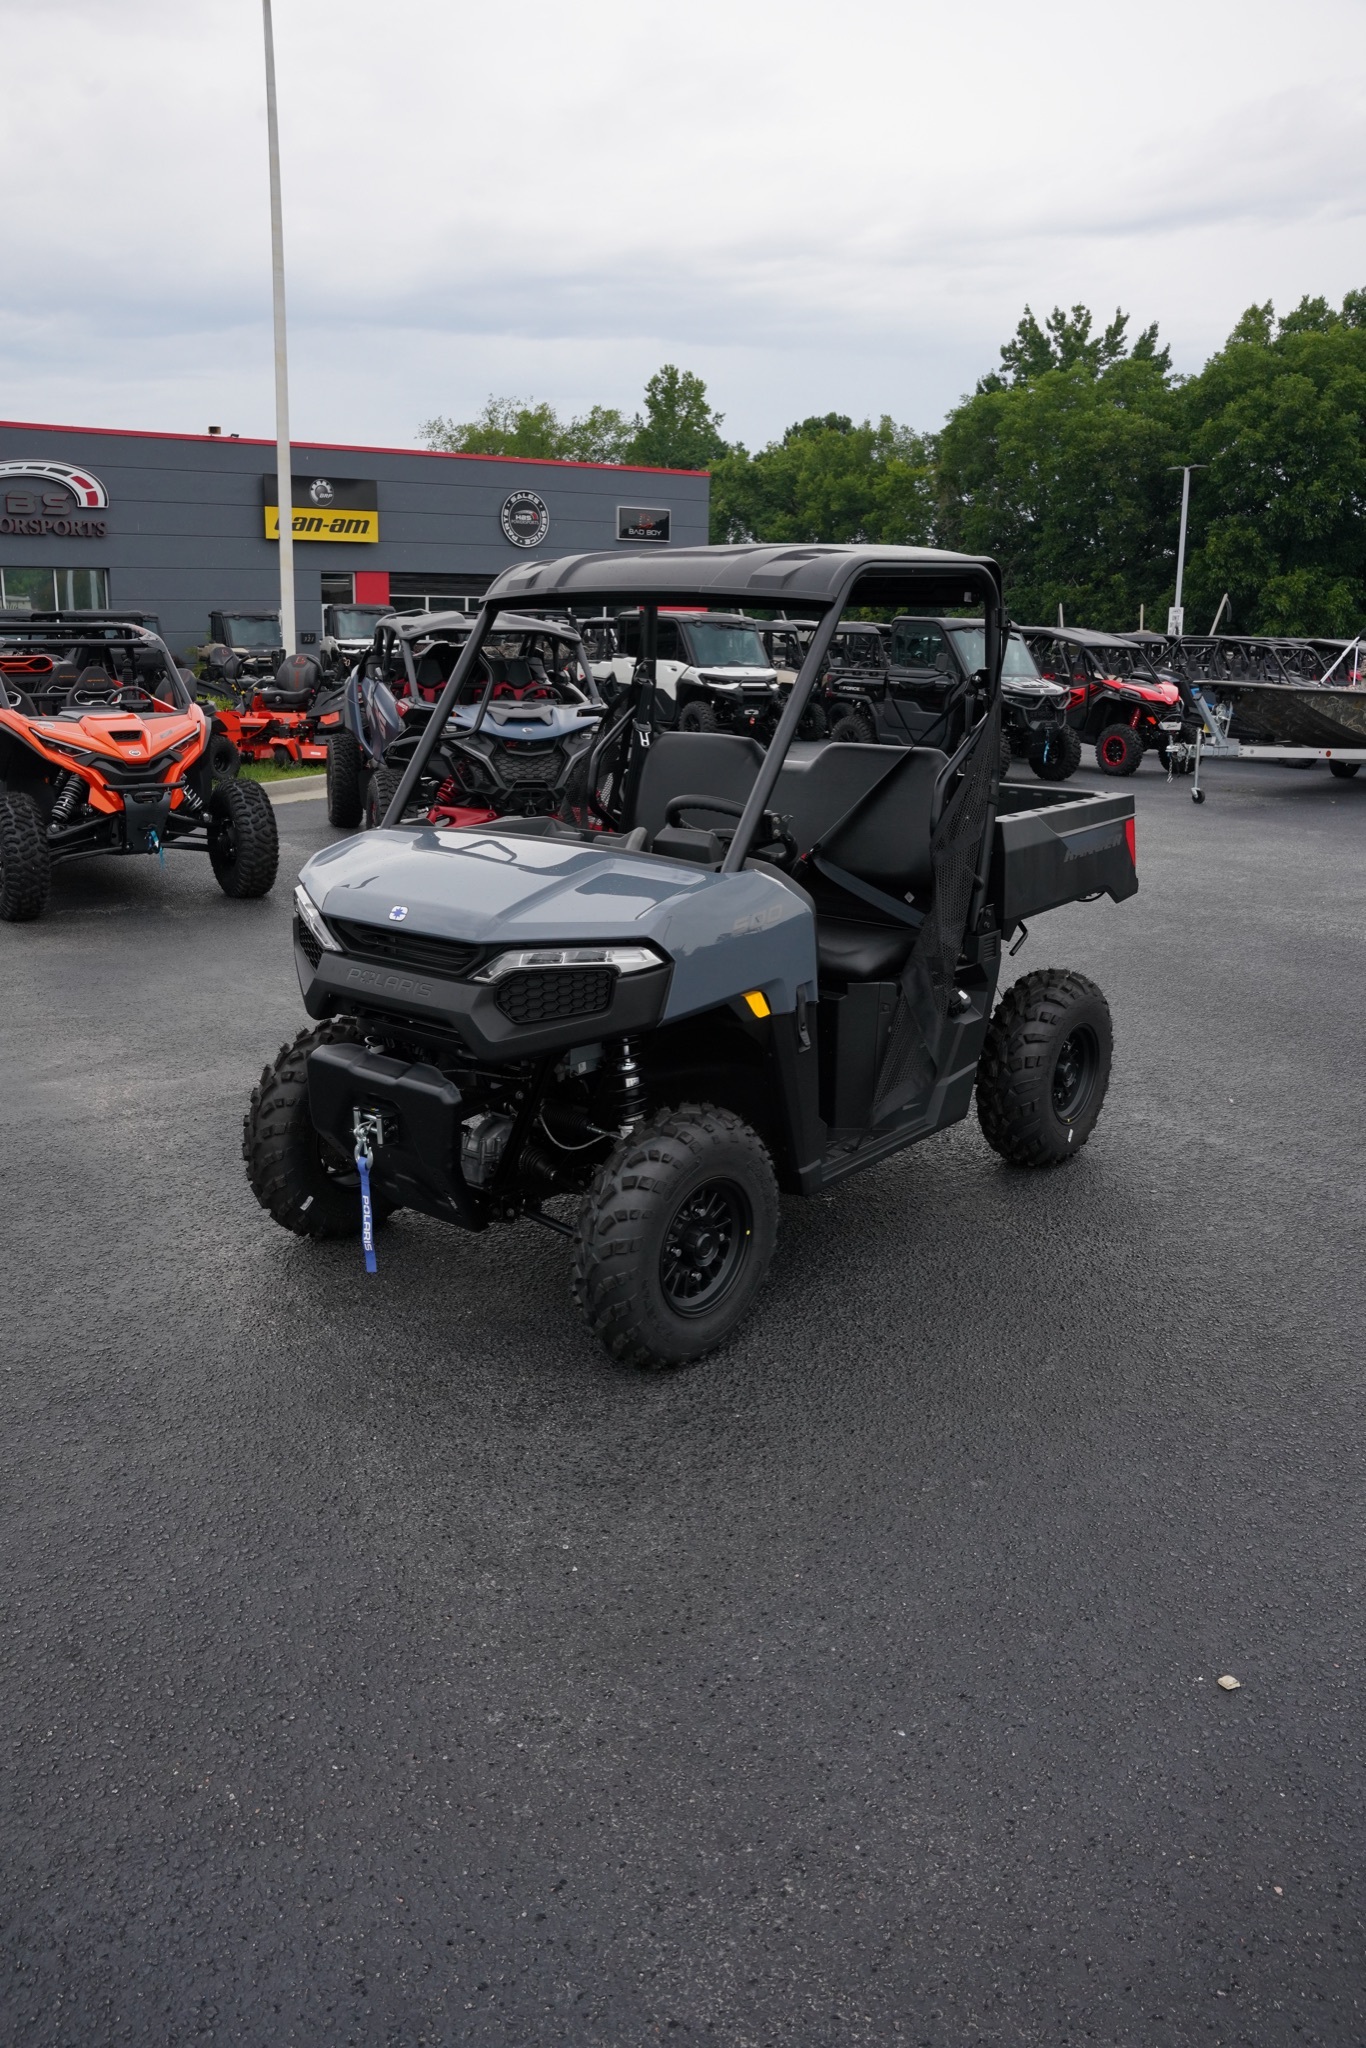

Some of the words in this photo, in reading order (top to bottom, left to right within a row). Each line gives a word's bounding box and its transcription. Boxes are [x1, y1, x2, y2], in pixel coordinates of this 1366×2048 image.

[510, 493, 540, 504] SALES
[503, 509, 518, 541] PARTS
[525, 510, 547, 545] SERVICE
[346, 967, 435, 998] POLARIS
[362, 1195, 373, 1251] POLARIS
